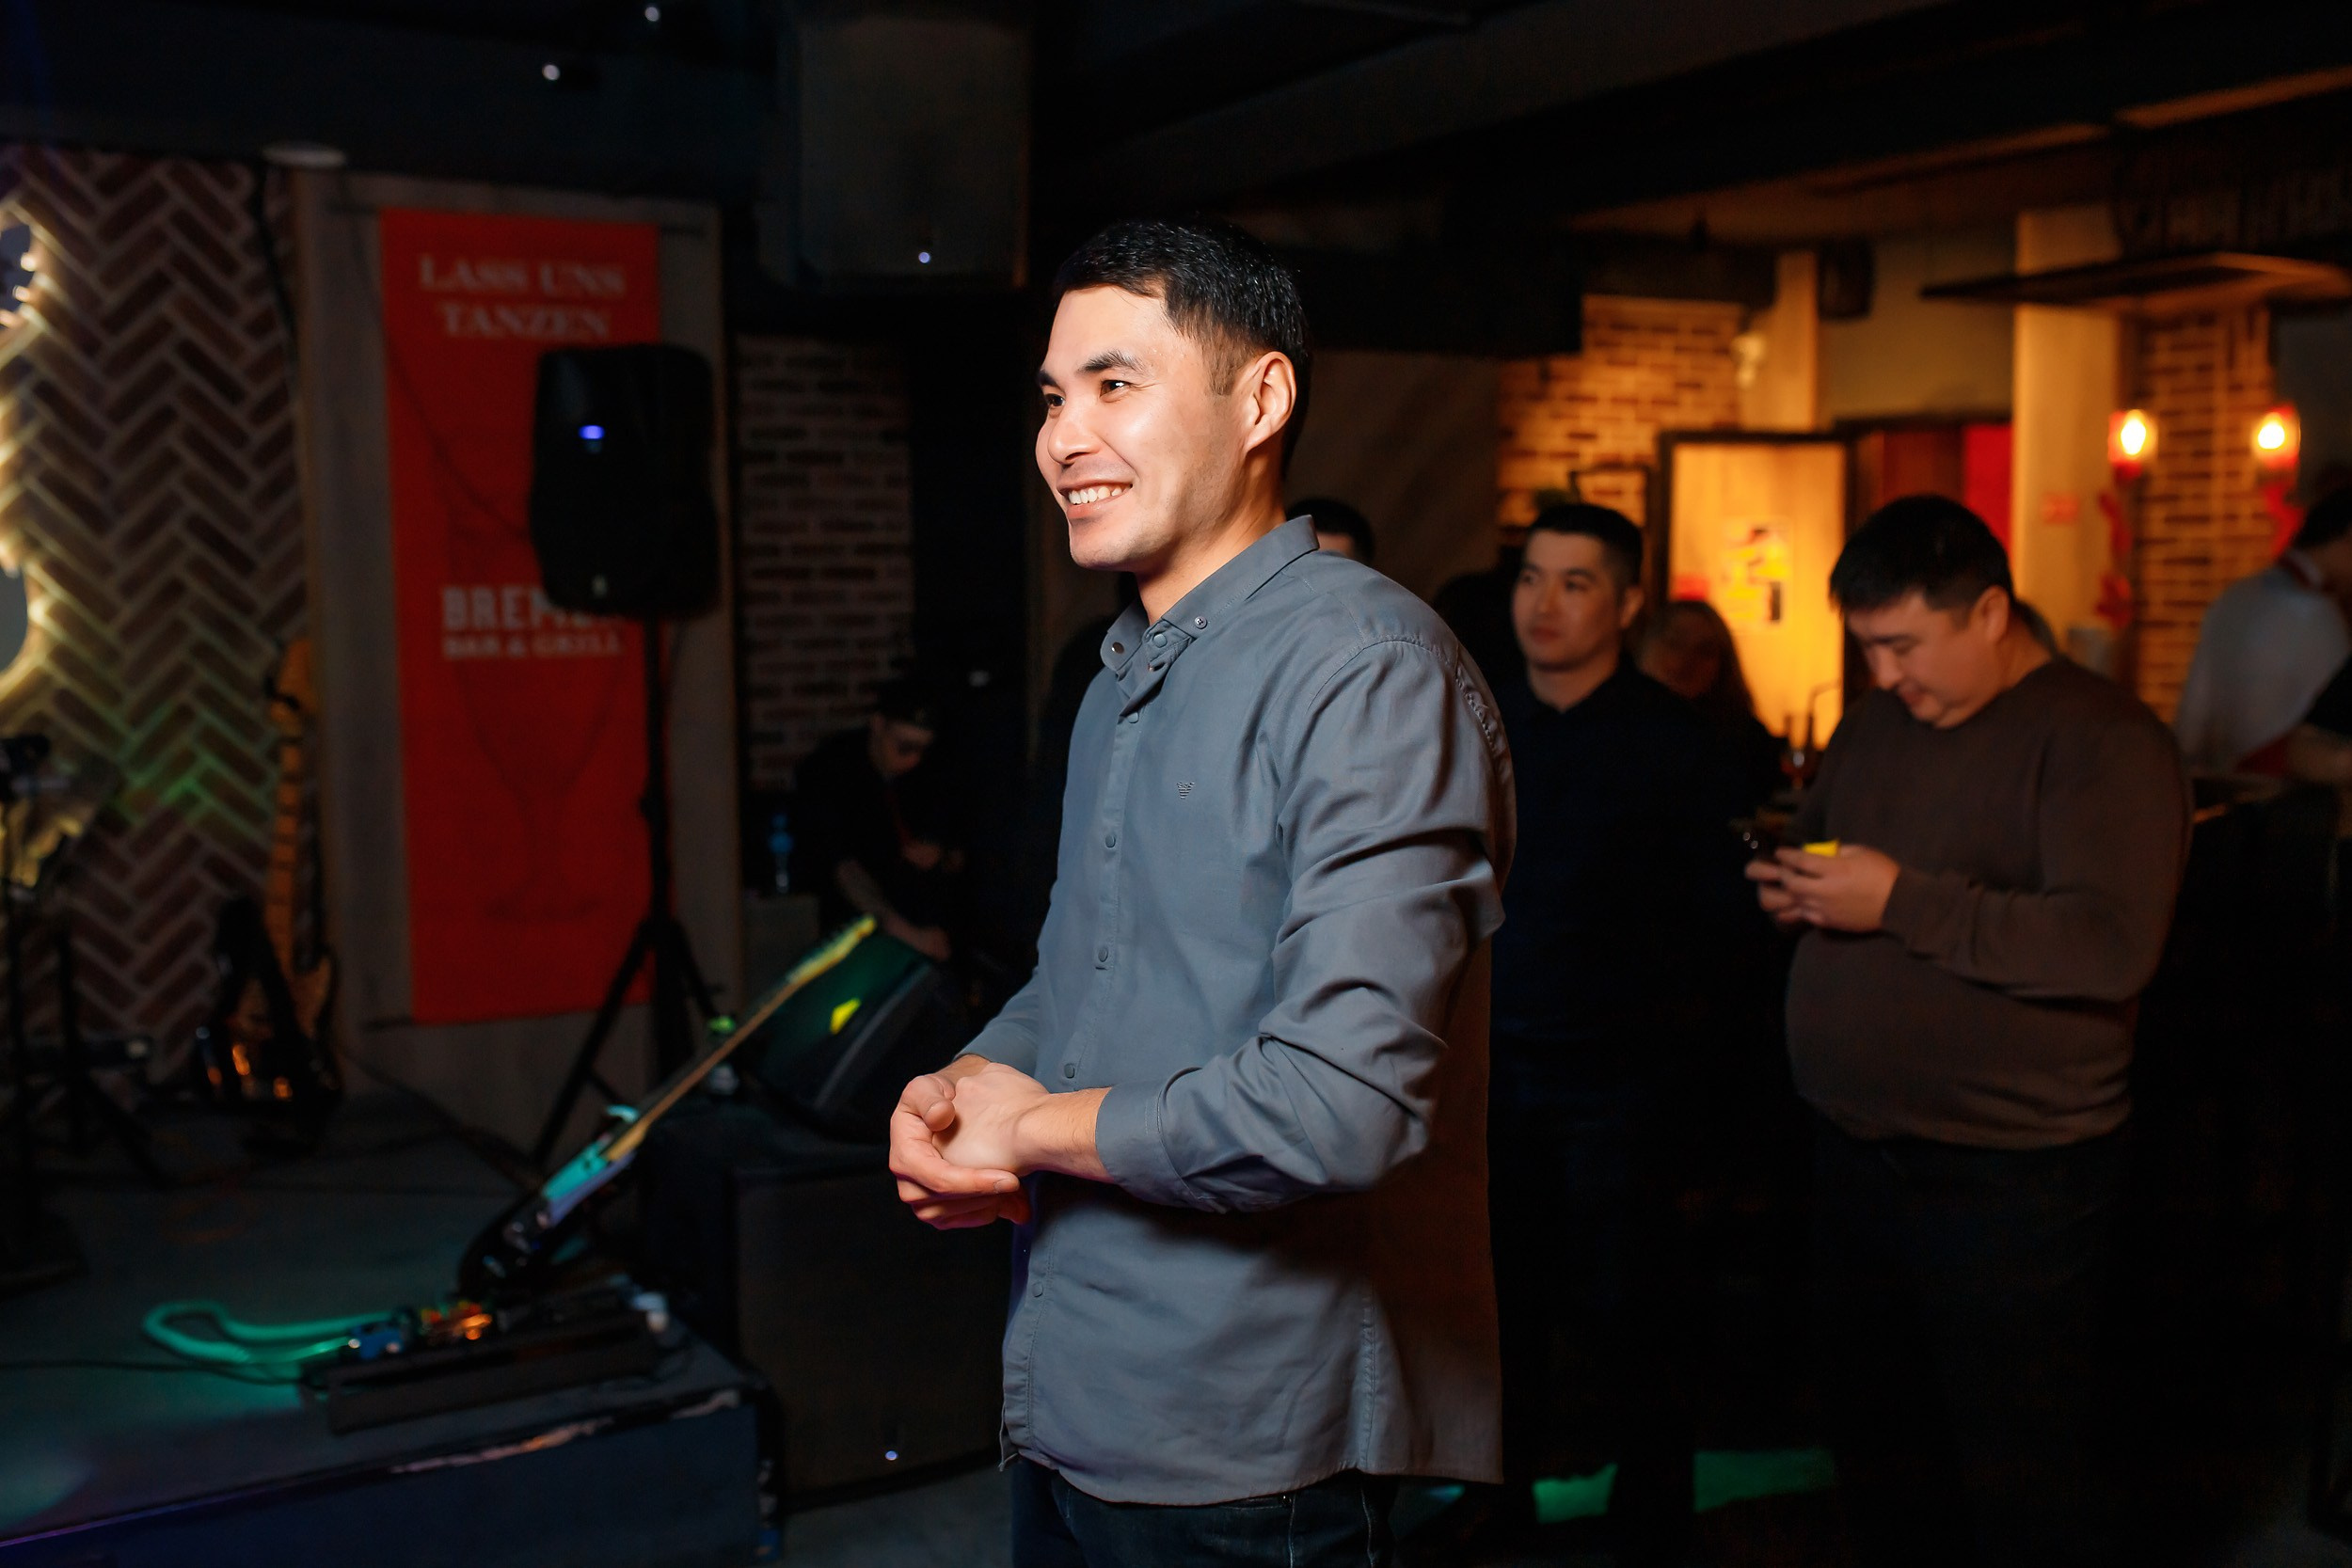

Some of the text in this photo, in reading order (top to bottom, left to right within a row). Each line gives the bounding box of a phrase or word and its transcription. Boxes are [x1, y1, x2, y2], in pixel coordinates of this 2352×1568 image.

[420, 252, 627, 299] LASS UNS
[436, 299, 610, 341] TANZEN
[532, 631, 622, 659] GRILL
